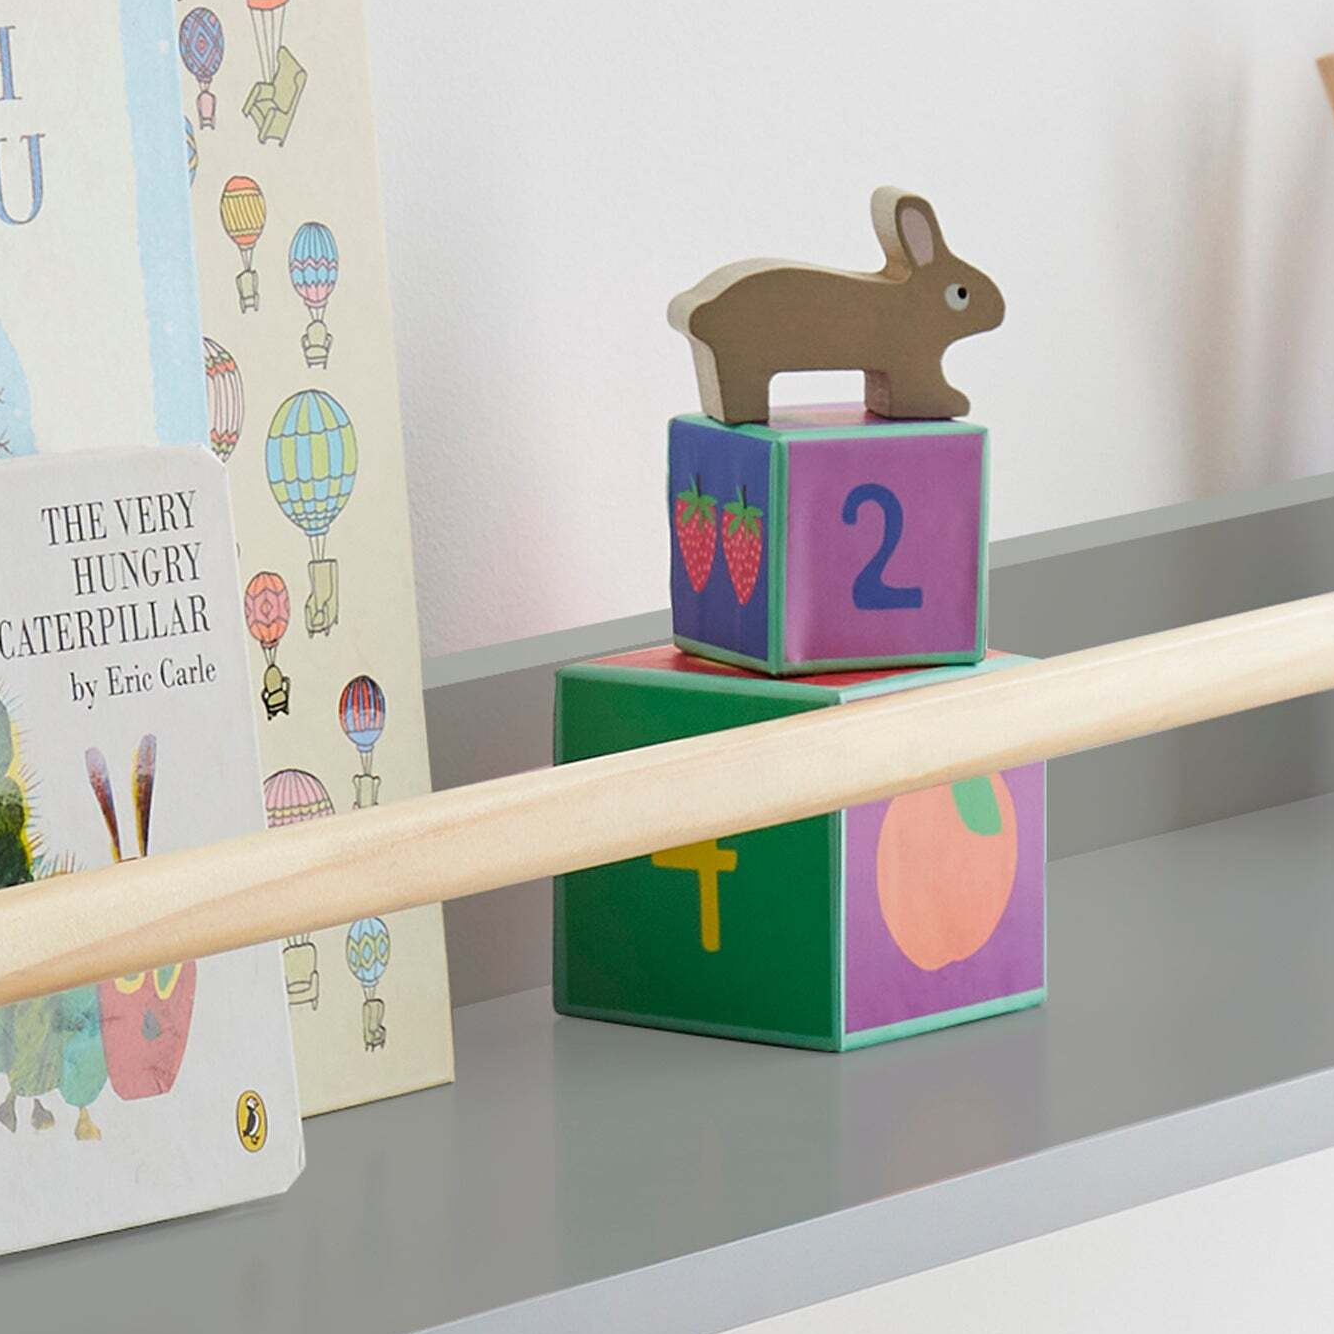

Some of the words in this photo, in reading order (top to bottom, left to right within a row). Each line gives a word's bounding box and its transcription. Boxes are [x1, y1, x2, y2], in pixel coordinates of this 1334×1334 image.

[41, 500, 107, 546] THE
[113, 490, 197, 536] VERY
[71, 542, 202, 596] HUNGRY
[842, 483, 923, 610] 2
[70, 673, 98, 710] by
[106, 664, 154, 697] Eric
[160, 655, 216, 689] Carle
